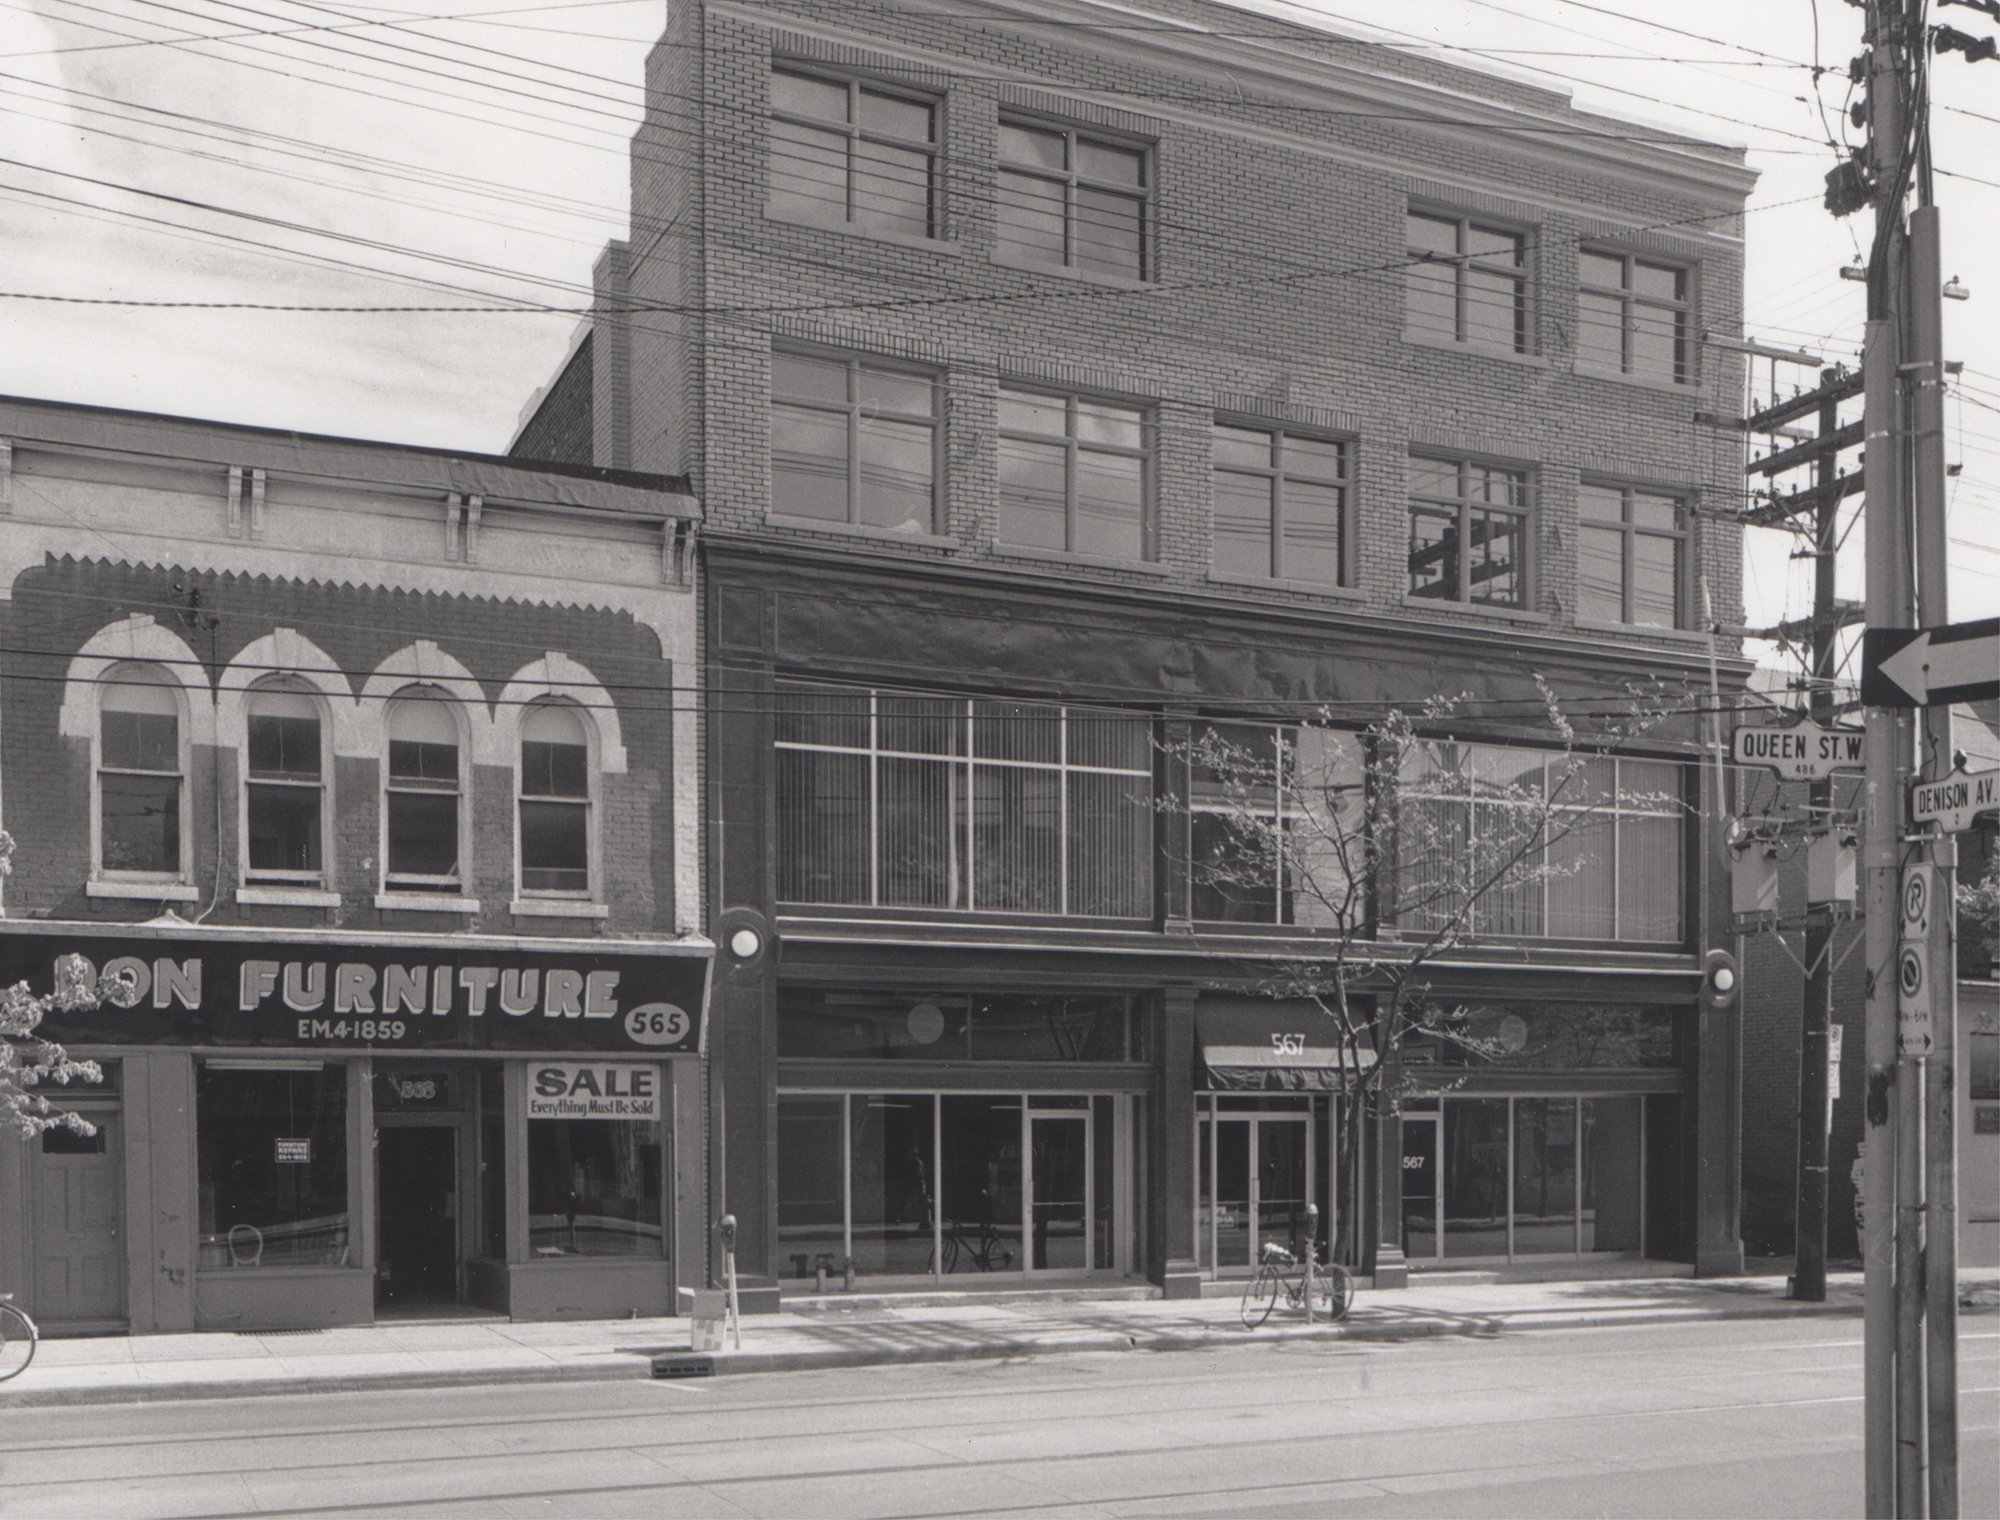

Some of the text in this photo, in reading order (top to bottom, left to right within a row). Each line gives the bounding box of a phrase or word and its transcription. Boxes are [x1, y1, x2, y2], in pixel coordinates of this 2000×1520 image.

[1743, 733, 1806, 759] QUEEN
[1795, 764, 1815, 775] 486
[1919, 777, 1997, 814] DENISON AV.
[54, 953, 620, 1018] DON FURNITURE
[631, 1012, 681, 1034] 565
[1271, 1033, 1306, 1056] 567
[401, 1081, 435, 1099] 565
[535, 1068, 653, 1097] SALE
[531, 1100, 653, 1116] Everything Must Be Sold
[1402, 1156, 1425, 1169] 567
